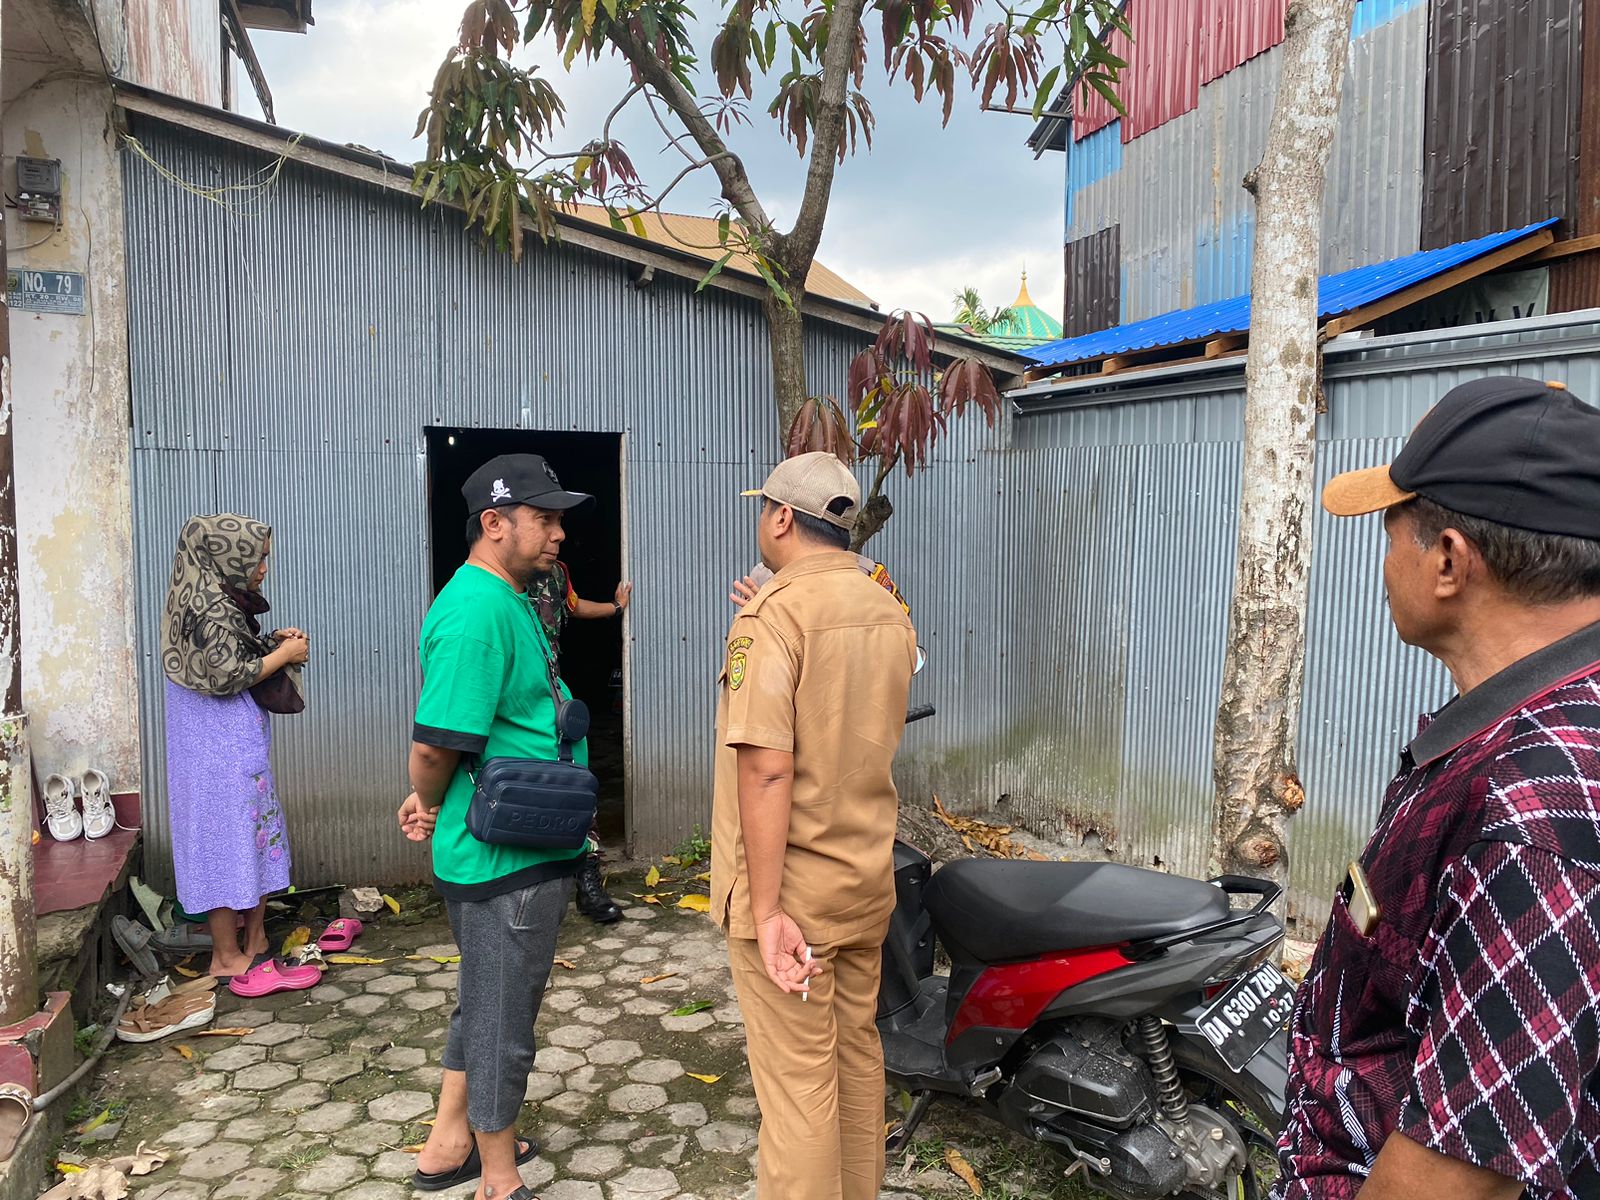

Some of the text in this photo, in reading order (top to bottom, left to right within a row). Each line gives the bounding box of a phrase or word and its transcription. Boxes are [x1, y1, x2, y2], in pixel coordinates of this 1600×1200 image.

[24, 271, 72, 294] NO. 79
[508, 810, 580, 832] PEDRO
[1201, 964, 1283, 1046] DA 6301 ZBU
